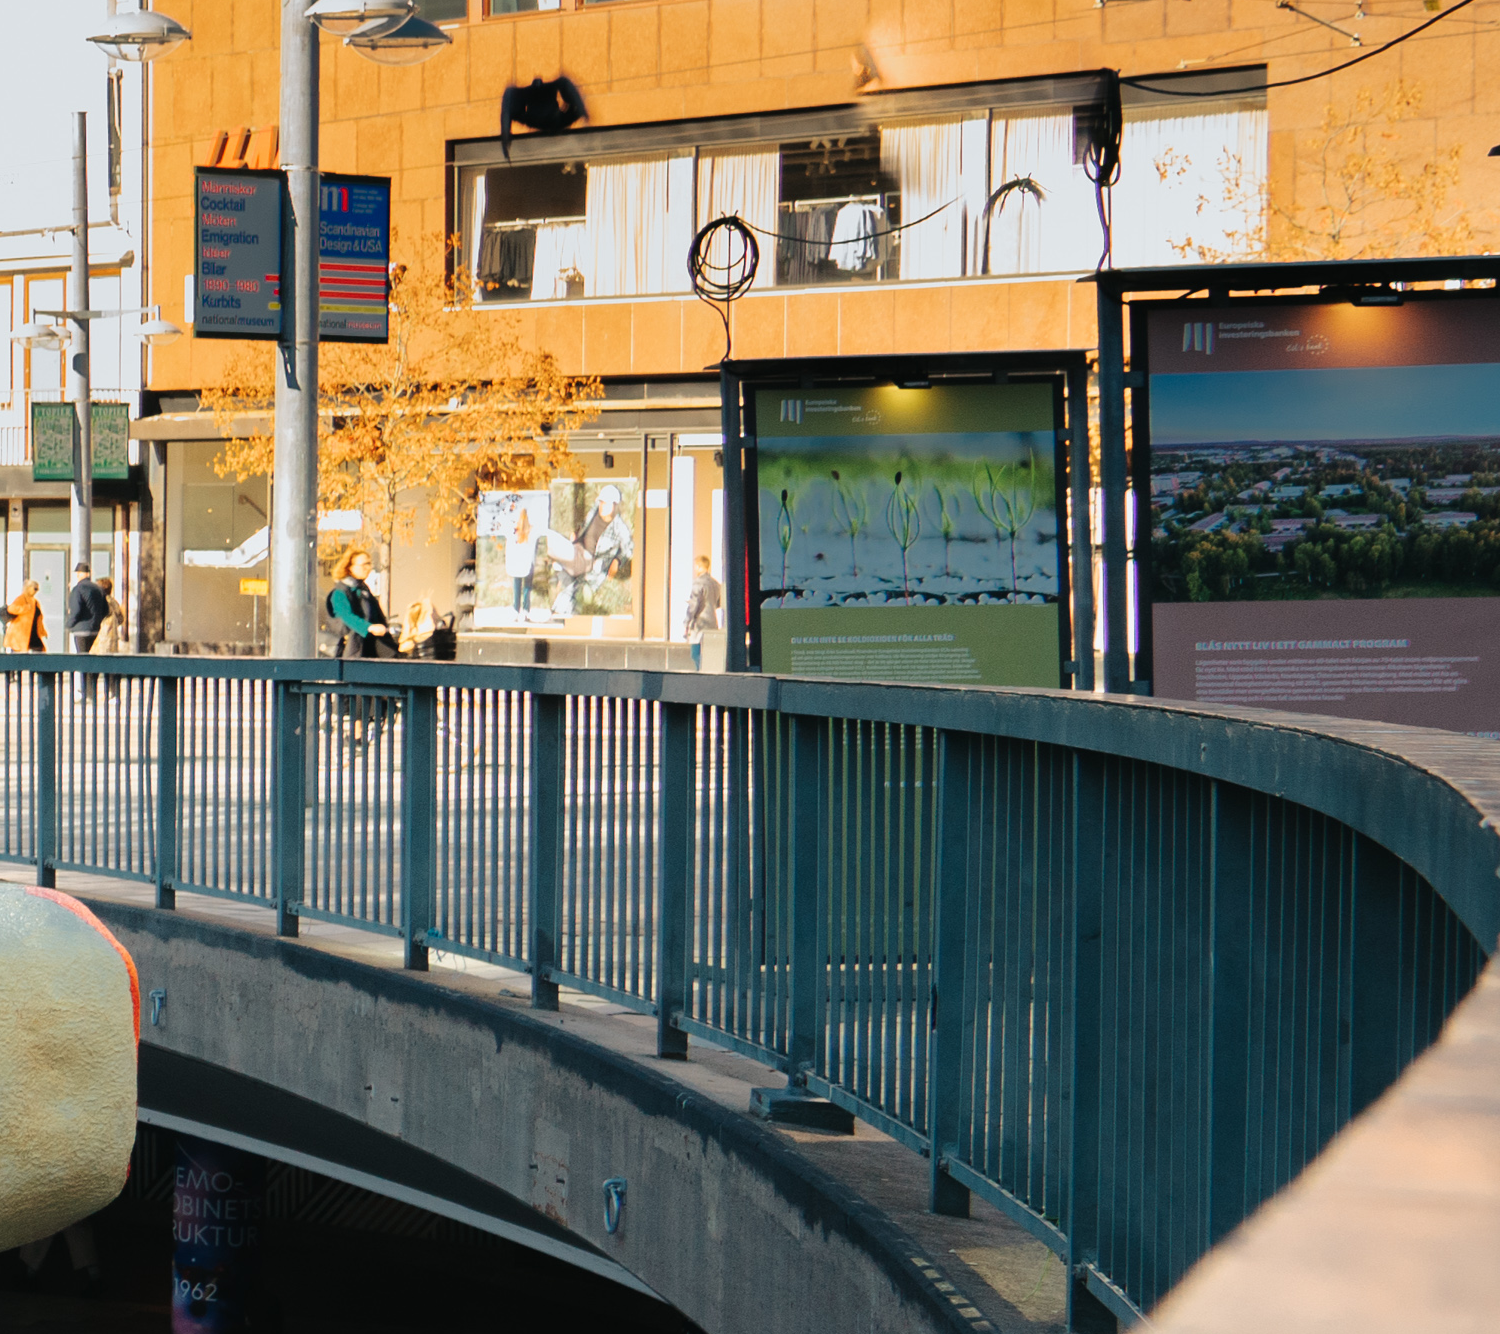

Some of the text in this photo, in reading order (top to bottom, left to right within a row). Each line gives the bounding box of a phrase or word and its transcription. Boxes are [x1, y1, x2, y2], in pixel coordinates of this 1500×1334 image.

[201, 180, 257, 195] Människor
[201, 196, 245, 212] Cocktail
[202, 213, 236, 226] Möten
[319, 221, 380, 238] Scandinavian
[201, 229, 259, 246] Emigration
[319, 236, 382, 253] Design & USA
[202, 245, 231, 259] Idéer
[202, 262, 227, 275] Bilar
[202, 295, 241, 309] Kurbits
[1195, 639, 1222, 651] BLÅS
[1223, 641, 1251, 651] NYTT
[1252, 641, 1271, 650] LIV
[1276, 641, 1297, 650] ETT
[1297, 639, 1352, 650] GAMMALT
[1353, 638, 1409, 648] PROGRAM
[176, 1165, 244, 1193] EMO-
[173, 1276, 218, 1303] 1962
